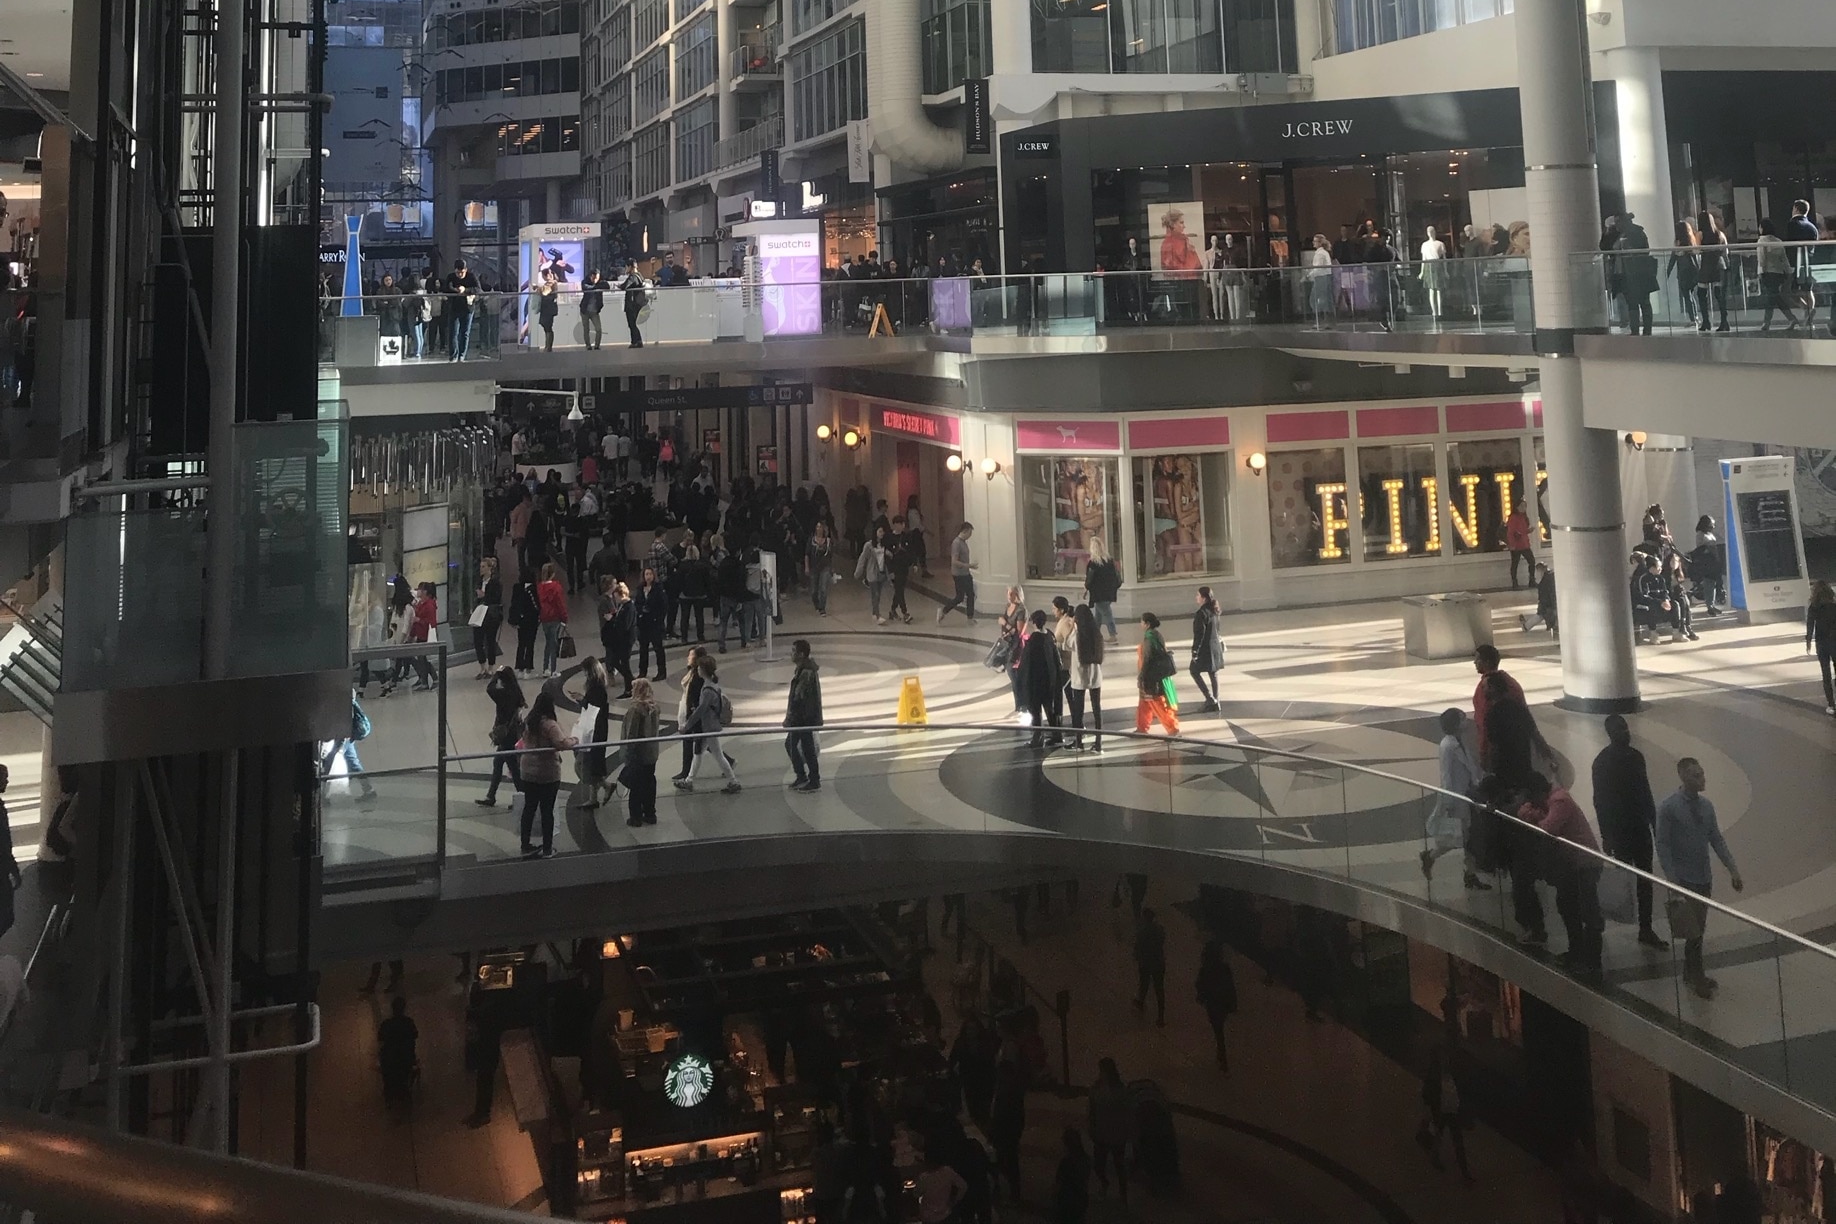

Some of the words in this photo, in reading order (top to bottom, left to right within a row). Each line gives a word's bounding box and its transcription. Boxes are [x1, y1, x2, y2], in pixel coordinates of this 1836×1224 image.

[973, 82, 981, 99] BAY
[974, 100, 982, 141] HUDSON'S
[1281, 119, 1354, 138] J.CREW
[1017, 142, 1051, 152] J.CREW
[544, 225, 583, 235] swatch
[767, 239, 804, 250] swatch
[796, 256, 820, 332] SKIN
[647, 395, 675, 407] Queen
